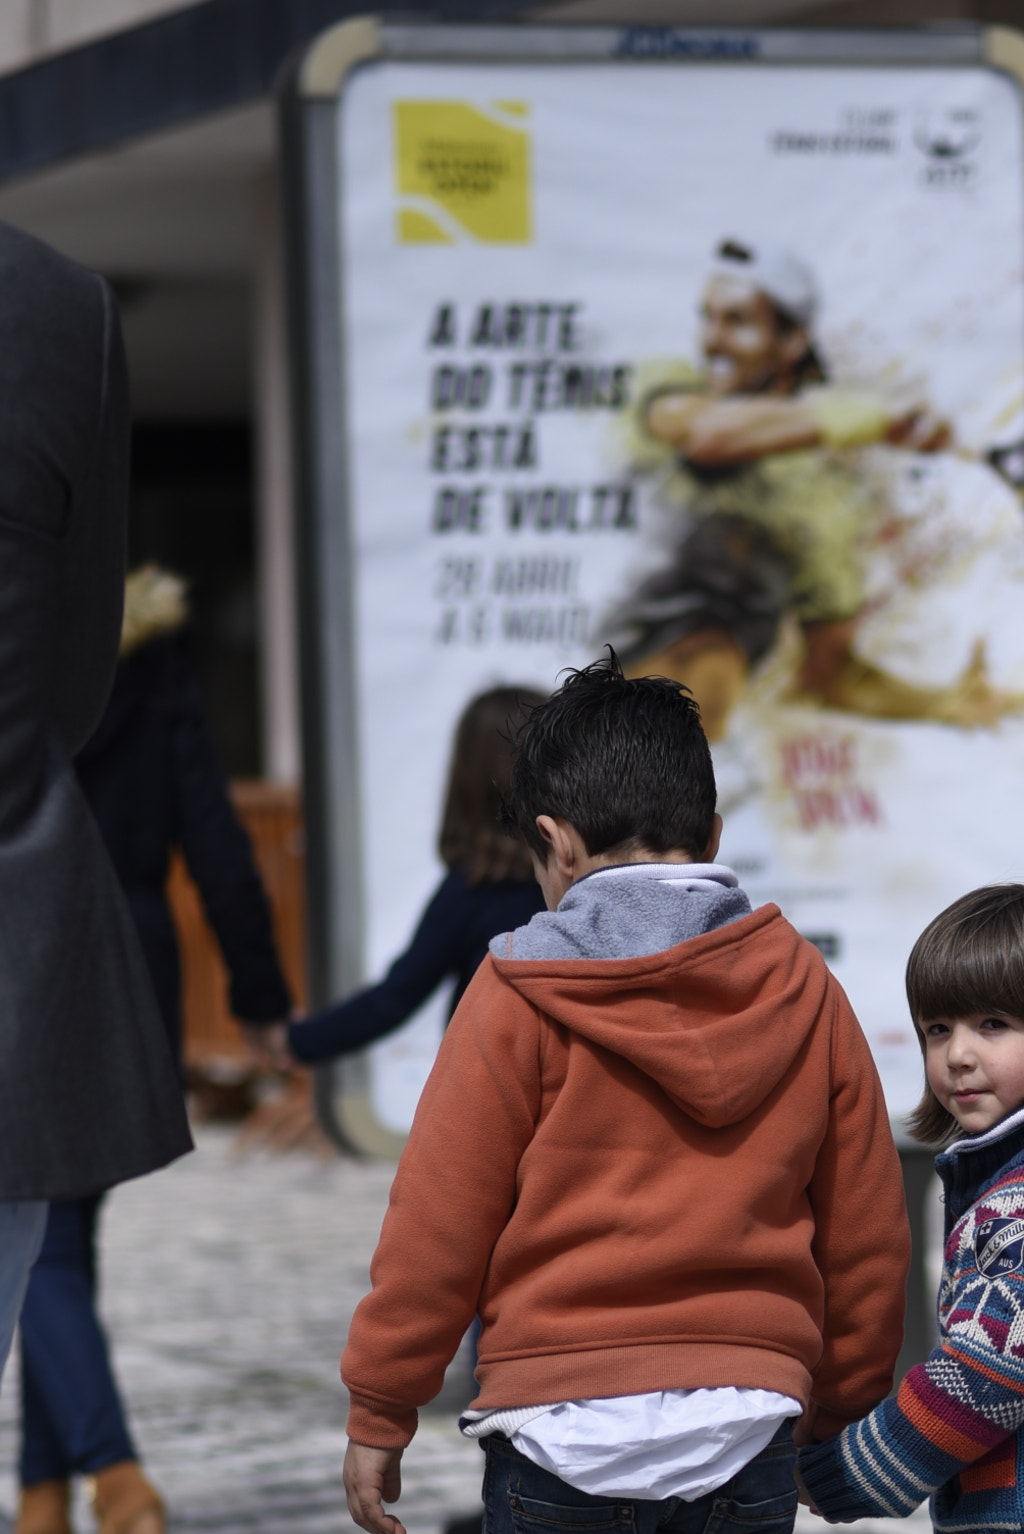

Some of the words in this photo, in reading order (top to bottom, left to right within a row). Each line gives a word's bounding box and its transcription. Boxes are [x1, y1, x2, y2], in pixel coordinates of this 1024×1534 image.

[428, 301, 455, 348] A
[470, 301, 581, 348] ARTE
[431, 363, 493, 411] DO
[431, 418, 537, 472] ESTÁ
[432, 485, 488, 533] DE
[505, 485, 636, 533] VOLTA
